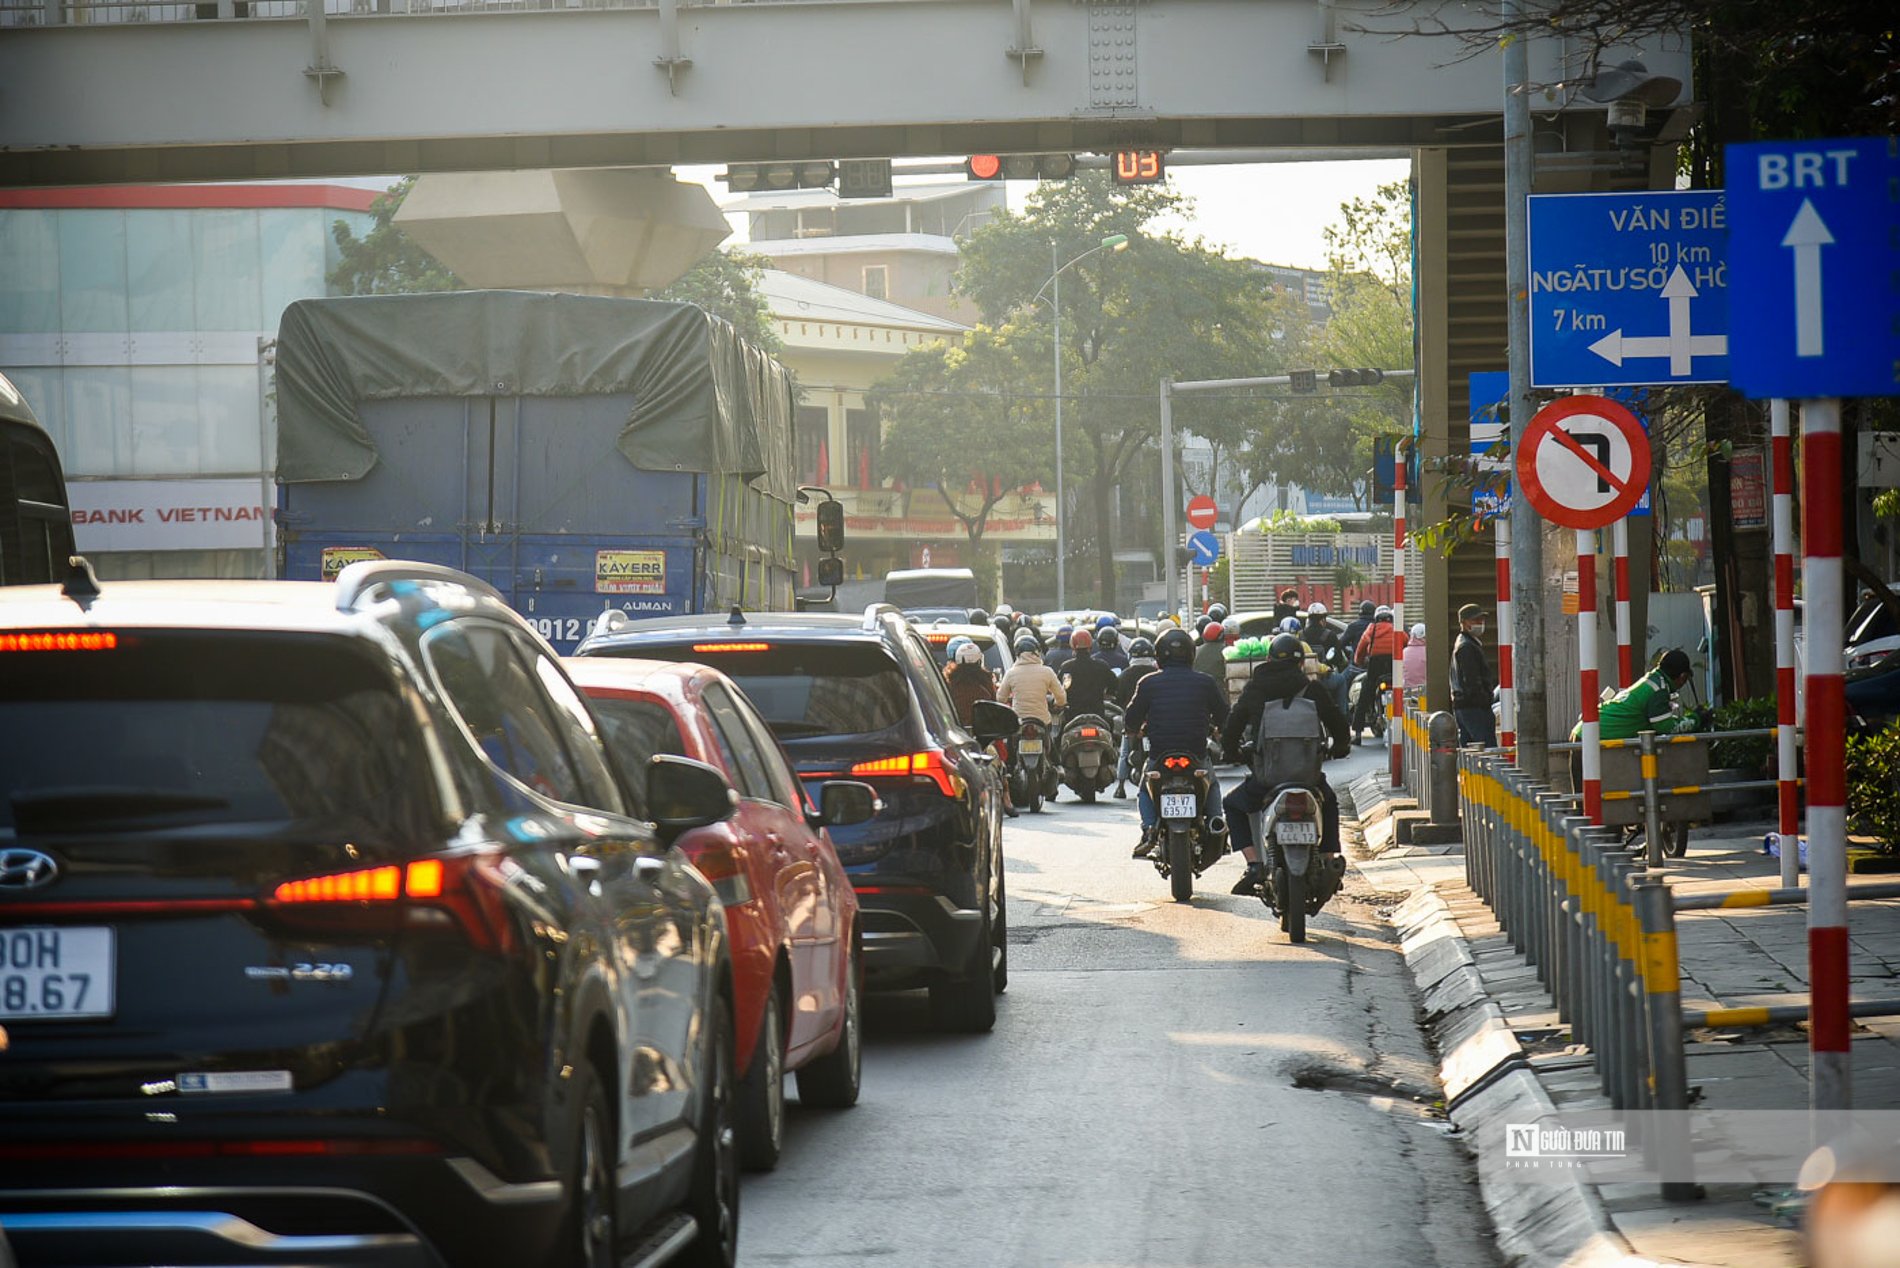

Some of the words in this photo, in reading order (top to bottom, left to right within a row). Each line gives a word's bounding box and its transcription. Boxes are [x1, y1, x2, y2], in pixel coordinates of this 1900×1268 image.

[1118, 152, 1158, 178] 03
[1758, 150, 1857, 190] BRT
[1609, 204, 1670, 231] VĂN
[1650, 242, 1670, 264] 10
[1677, 242, 1710, 263] km
[1553, 309, 1566, 331] 7
[1572, 309, 1606, 331] km
[71, 508, 145, 525] BANK
[623, 602, 672, 611] AUMAN
